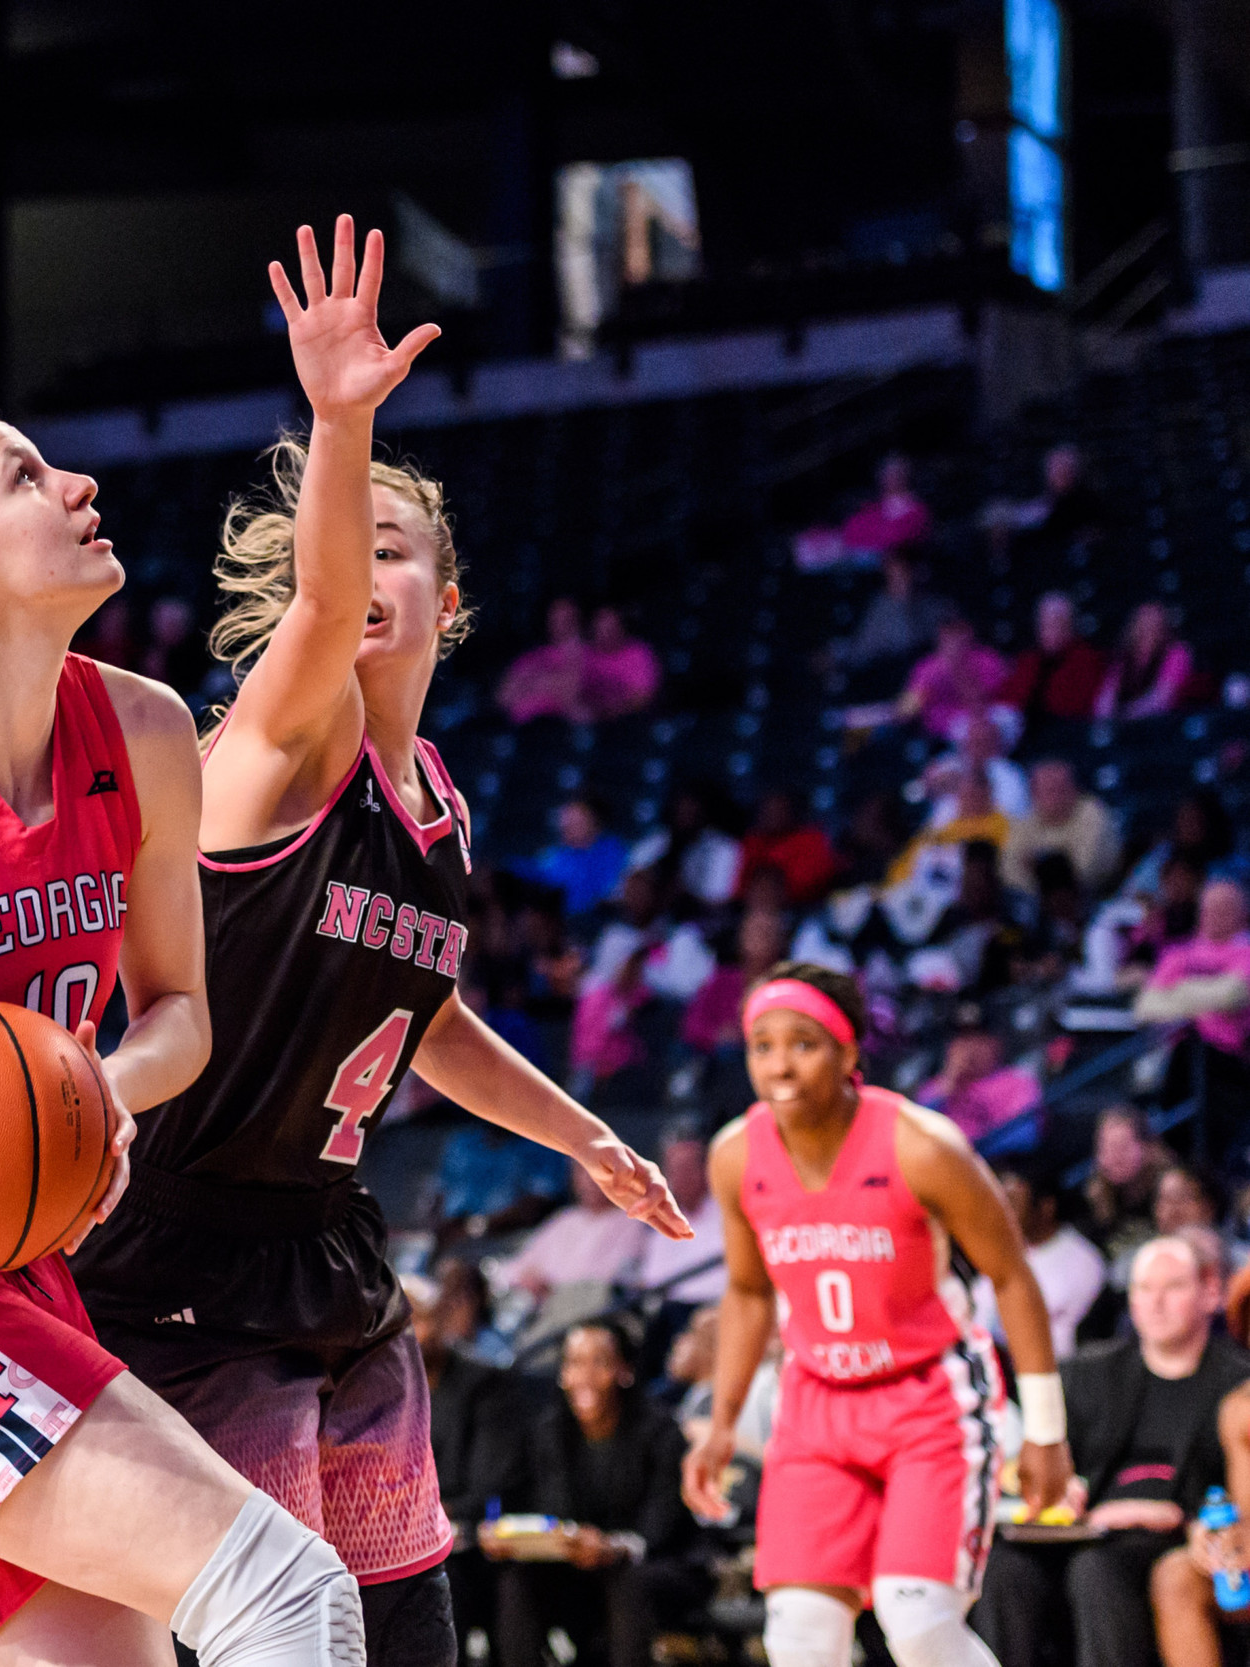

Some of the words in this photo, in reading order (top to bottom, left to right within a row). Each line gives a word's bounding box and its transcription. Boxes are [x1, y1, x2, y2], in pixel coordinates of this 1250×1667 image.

[318, 1007, 414, 1167] 4
[762, 1222, 896, 1266] GEORGIA
[815, 1268, 854, 1334] 0
